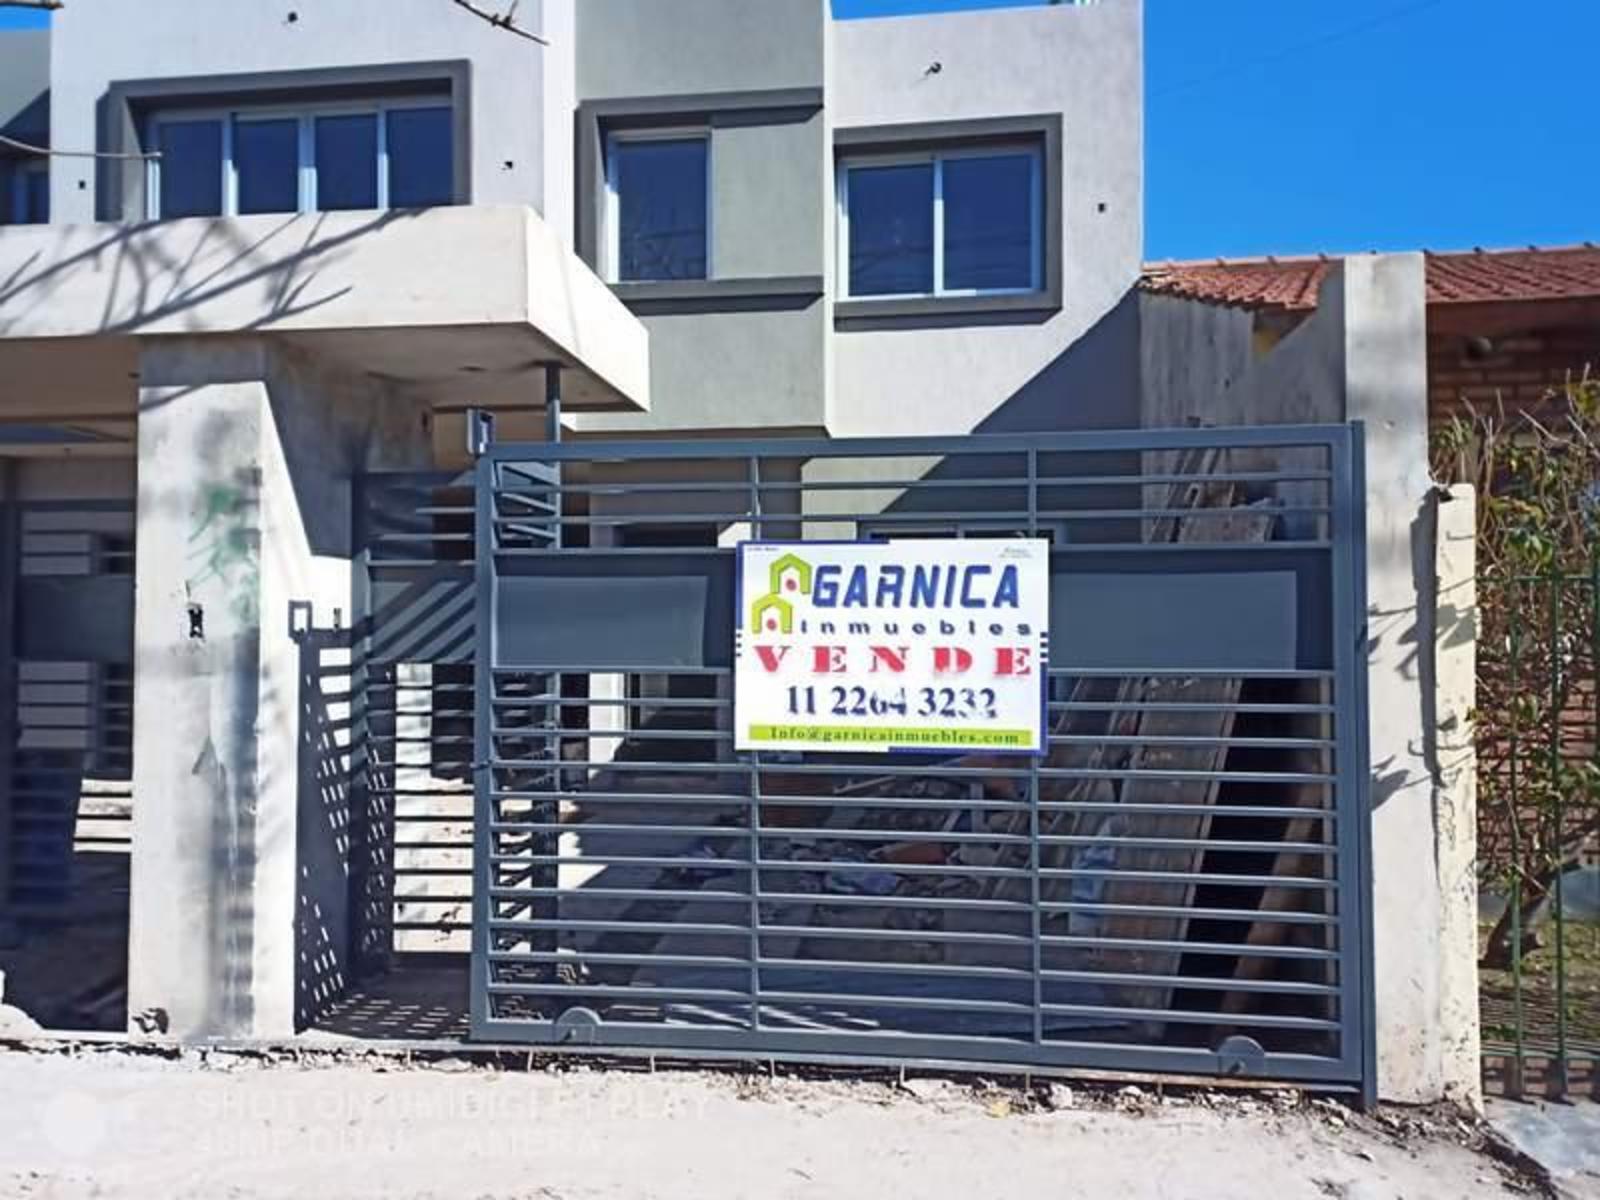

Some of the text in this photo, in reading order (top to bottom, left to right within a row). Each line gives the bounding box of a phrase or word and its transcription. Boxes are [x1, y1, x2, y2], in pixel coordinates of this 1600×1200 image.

[811, 564, 1021, 609] GARNICA
[800, 619, 1032, 636] inmuebles
[752, 645, 1032, 676] VENDE
[787, 685, 998, 719] 11 2264 3232
